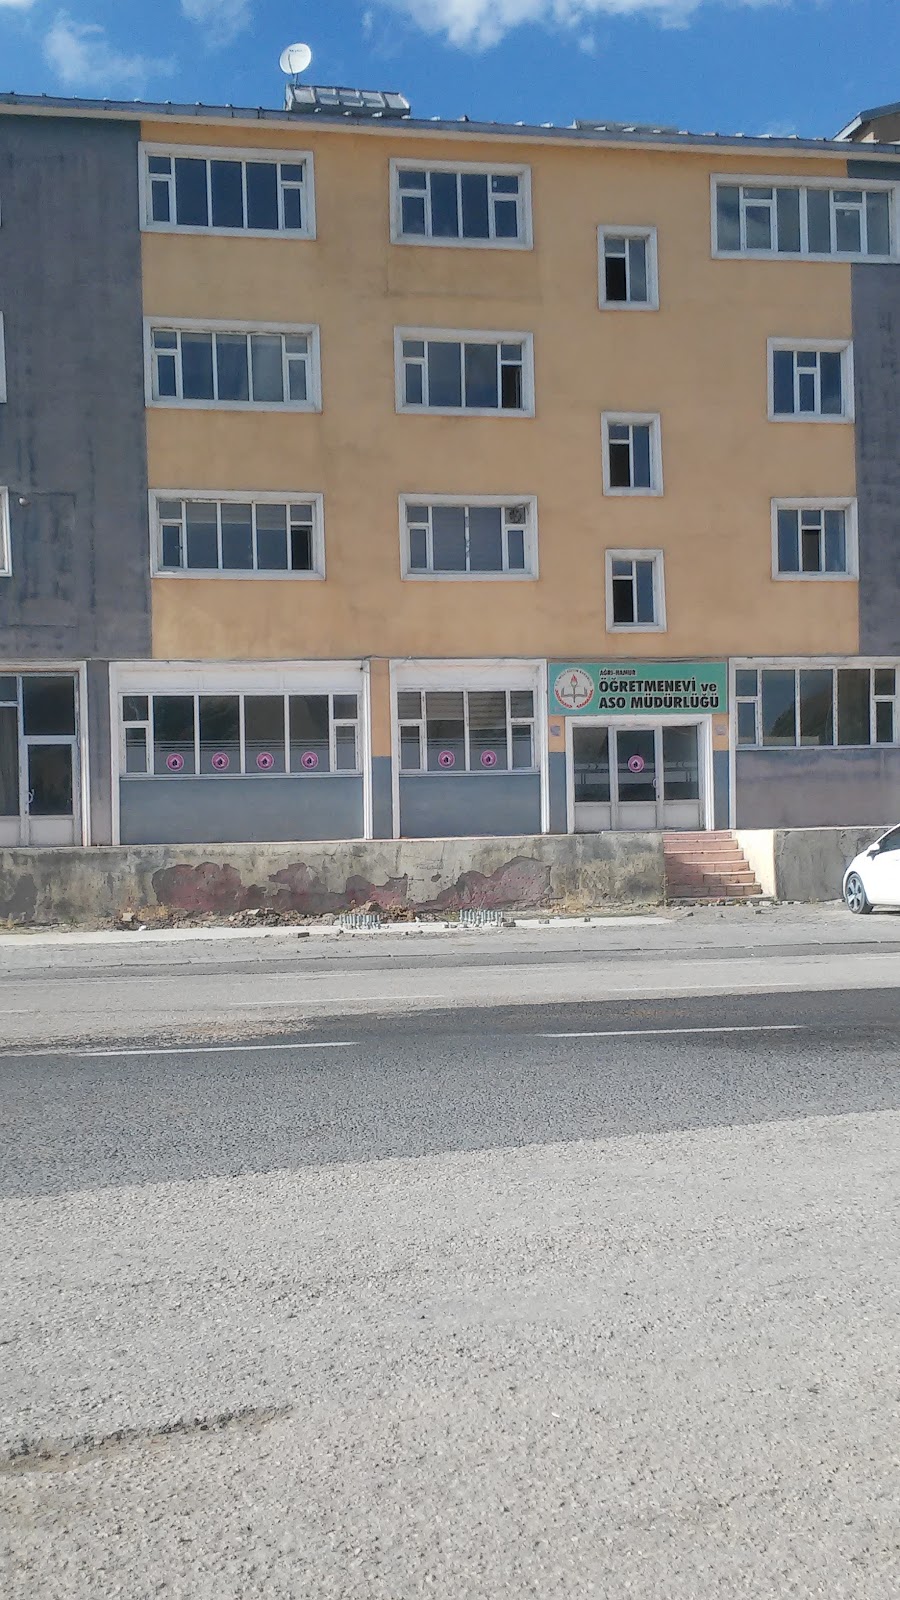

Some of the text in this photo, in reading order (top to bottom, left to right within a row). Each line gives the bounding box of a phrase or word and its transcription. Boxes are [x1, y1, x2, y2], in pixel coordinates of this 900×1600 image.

[598, 677, 696, 692] ÖĞRETMENEVİ
[700, 683, 717, 692] ve
[599, 697, 626, 708] ASO
[631, 693, 719, 708] MÜDÜRLÜĞÜ
